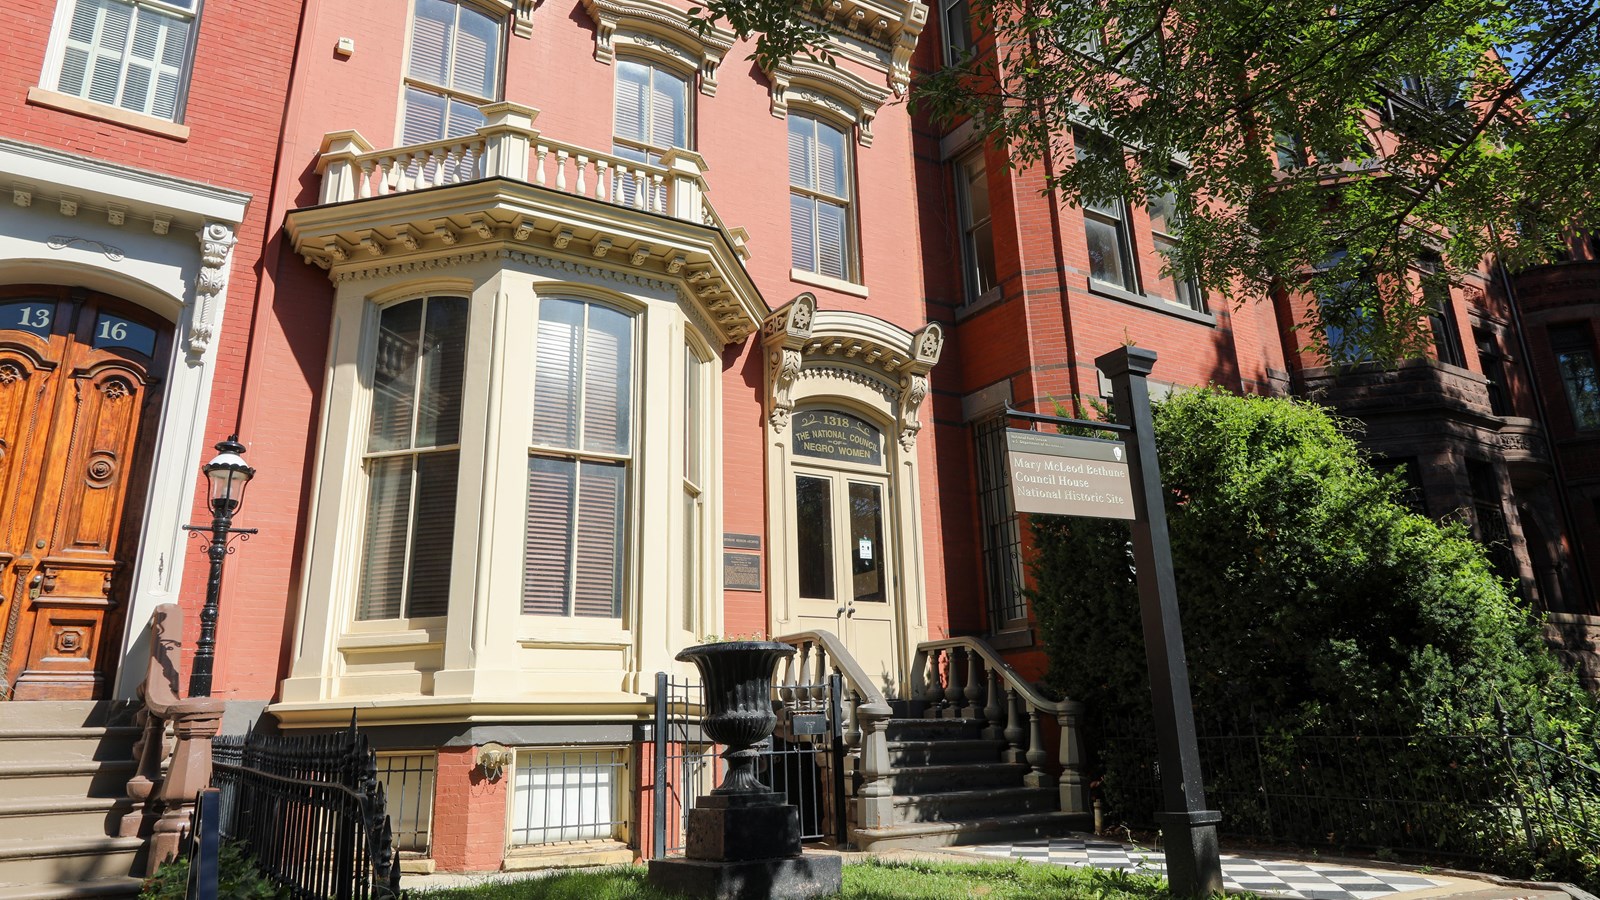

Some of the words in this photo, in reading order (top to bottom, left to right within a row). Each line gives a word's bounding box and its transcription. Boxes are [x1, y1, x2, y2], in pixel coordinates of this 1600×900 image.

[17, 306, 50, 328] 13
[97, 320, 128, 341] 16
[823, 415, 849, 428] 1318
[795, 431, 810, 441] THE
[812, 429, 847, 440] NATIONAL
[849, 434, 878, 453] COUNCIL
[803, 442, 835, 454] NEGRO
[838, 447, 871, 459] WOMEN
[1014, 458, 1041, 472] Mary
[1044, 461, 1084, 474] McLeod
[1086, 465, 1125, 478] Bethune
[1015, 472, 1056, 485] Council
[1058, 476, 1089, 488] House
[1017, 486, 1061, 500] National
[1064, 490, 1104, 503] Historic
[1105, 493, 1125, 504] Site
